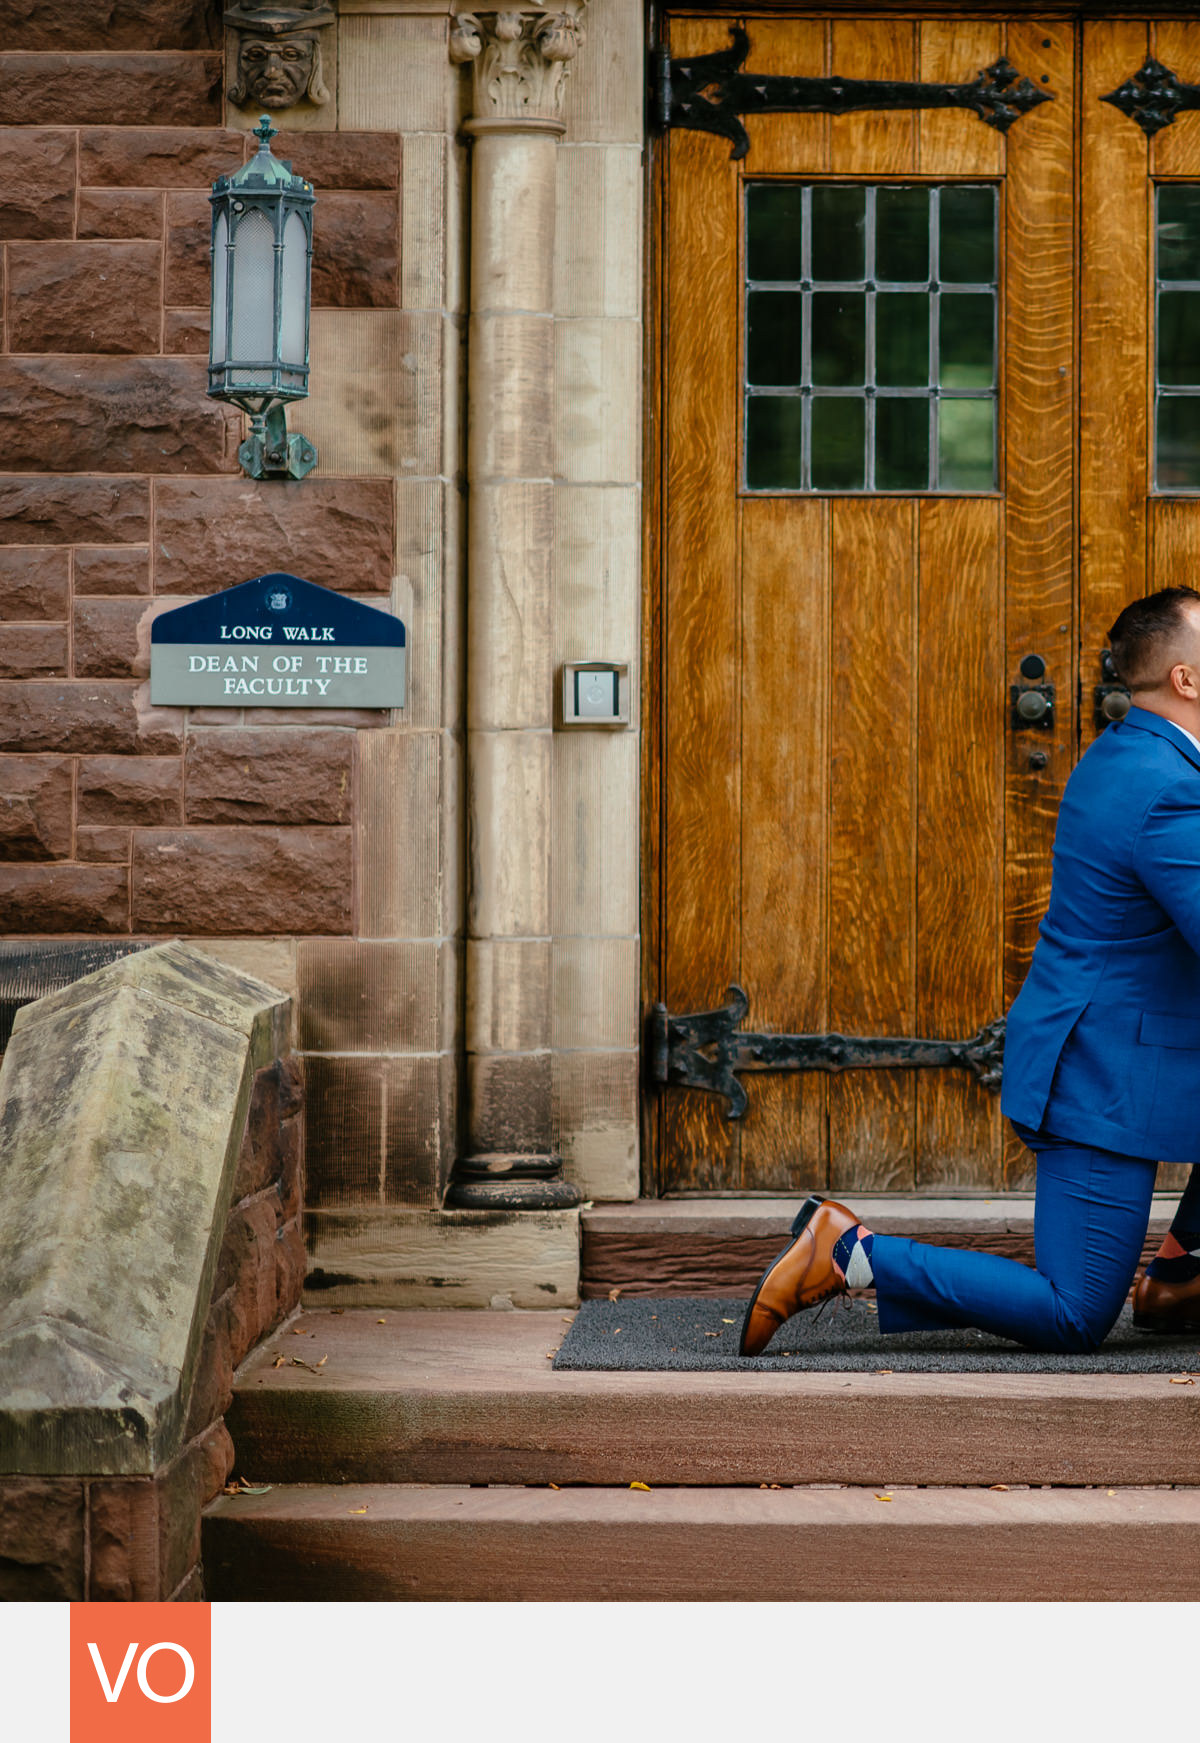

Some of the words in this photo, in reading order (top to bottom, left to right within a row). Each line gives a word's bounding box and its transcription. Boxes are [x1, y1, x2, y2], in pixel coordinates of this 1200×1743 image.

[220, 625, 273, 640] LONG
[282, 626, 335, 641] WALK
[188, 655, 260, 673] DEAN
[272, 655, 303, 674] OF
[315, 656, 368, 674] THE
[223, 677, 332, 695] FACULTY
